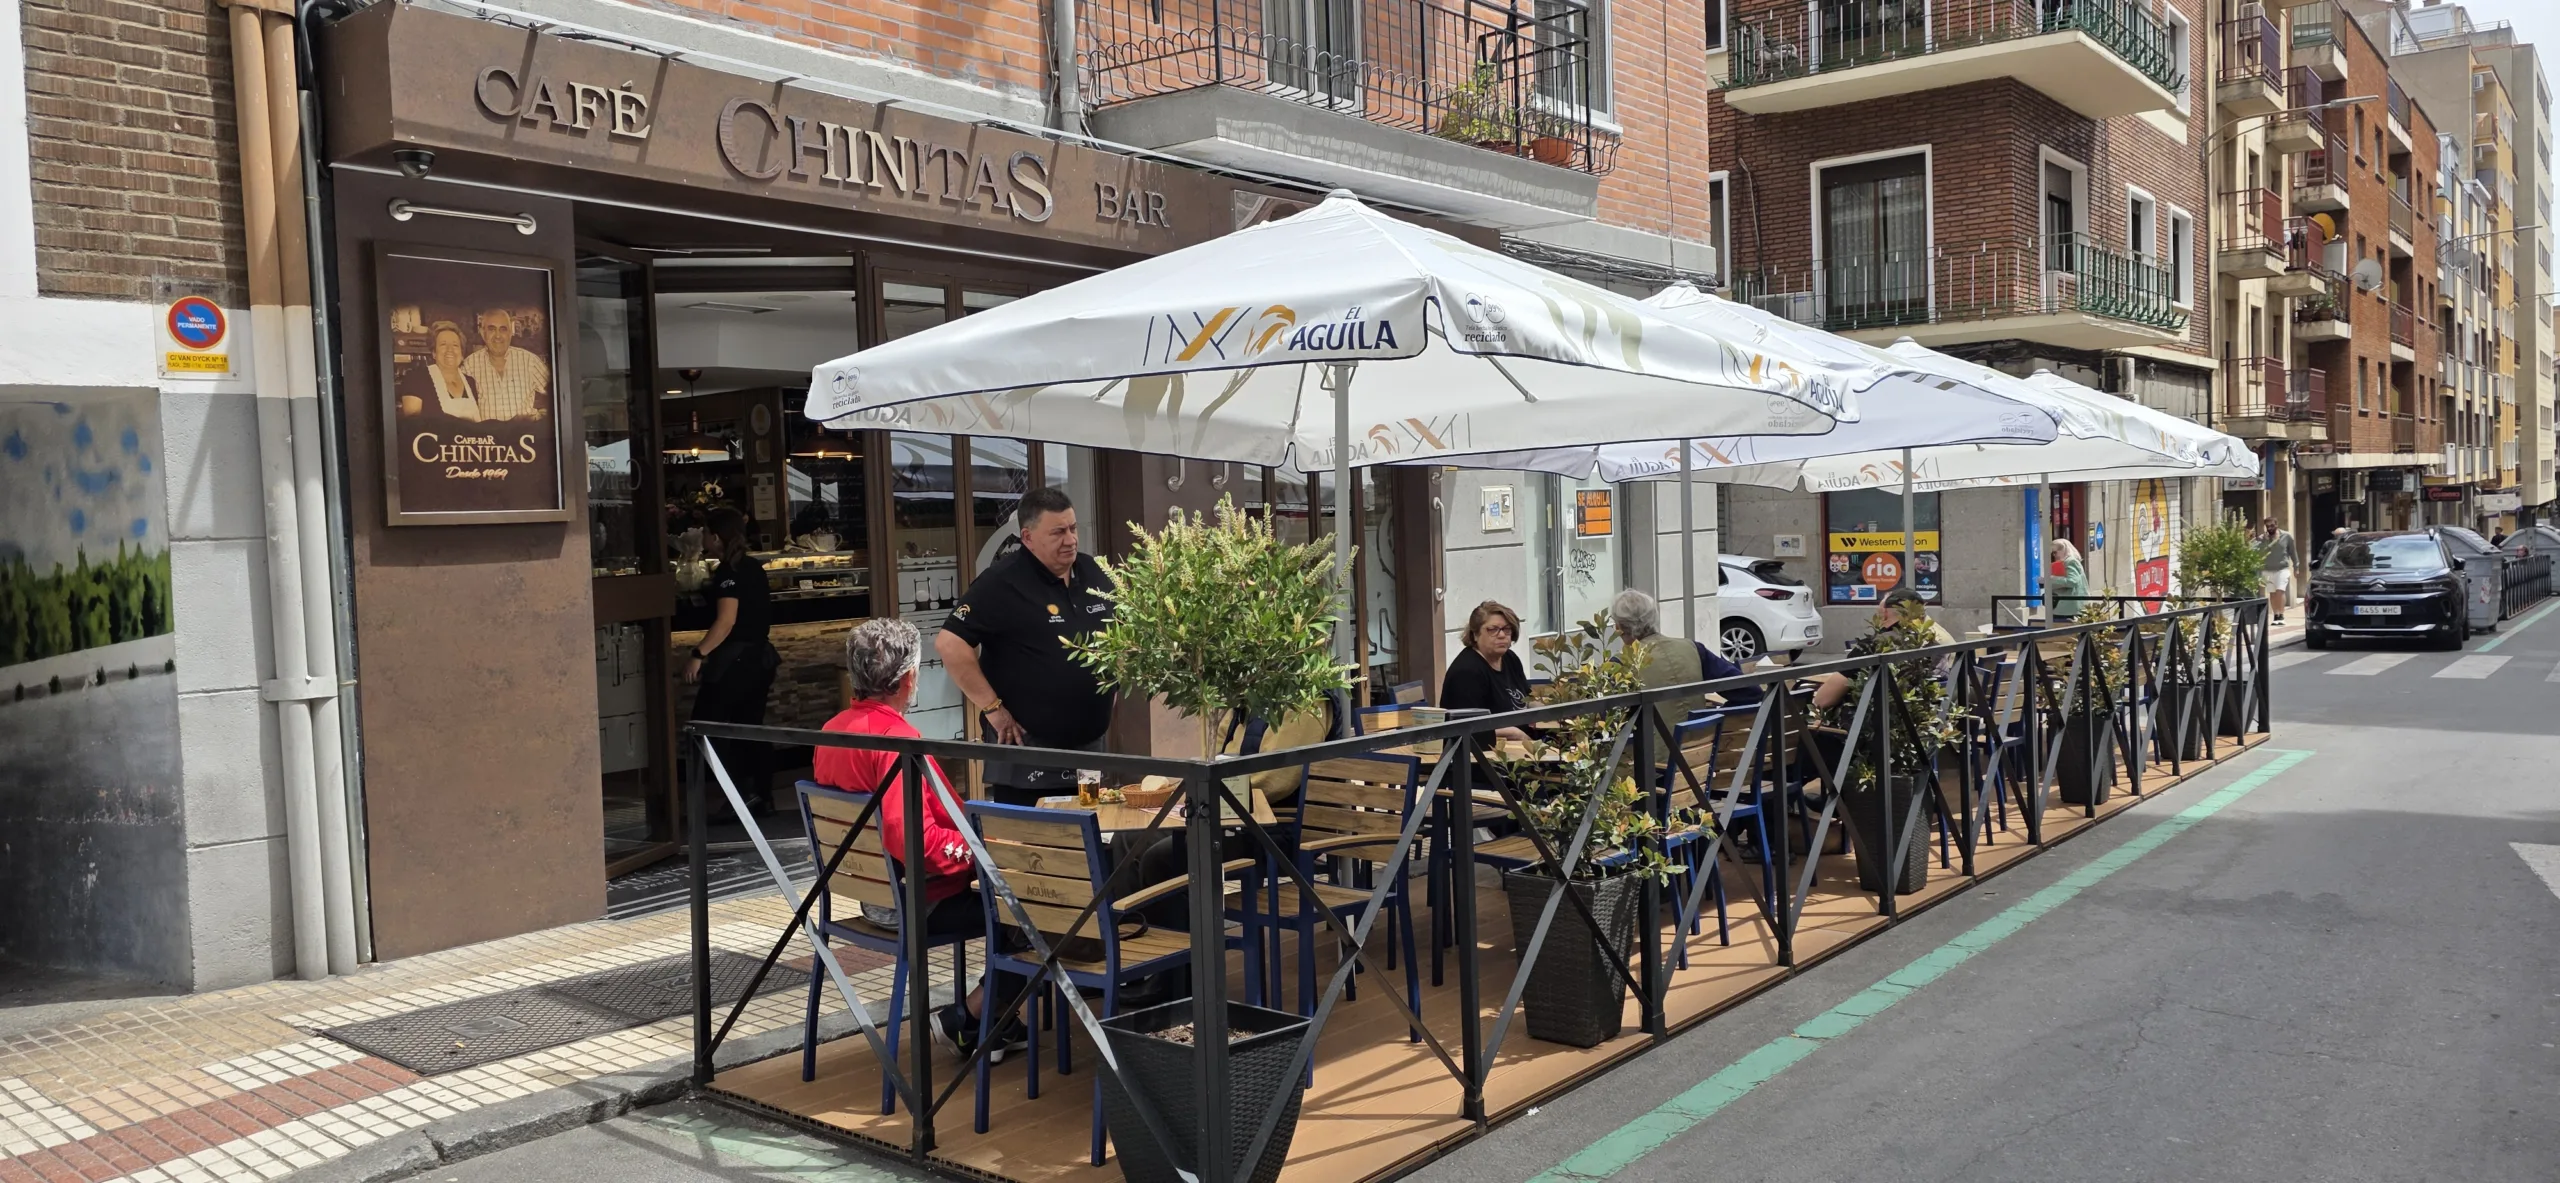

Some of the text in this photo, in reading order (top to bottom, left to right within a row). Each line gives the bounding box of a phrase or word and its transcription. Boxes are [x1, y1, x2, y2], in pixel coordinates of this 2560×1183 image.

[476, 65, 1171, 228] CAFÉ CHINITAS BAR
[1344, 306, 1362, 320] EL
[177, 322, 217, 330] PERMANENTE
[1287, 320, 1399, 351] ÁGUILA
[1464, 332, 1506, 343] reciclado
[412, 432, 537, 463] CHINITAS
[445, 466, 508, 480] Desde 1969
[1577, 491, 1585, 507] SE
[1859, 538, 1897, 546] Western
[1899, 538, 1928, 546] Uon
[1866, 557, 1897, 577] ria
